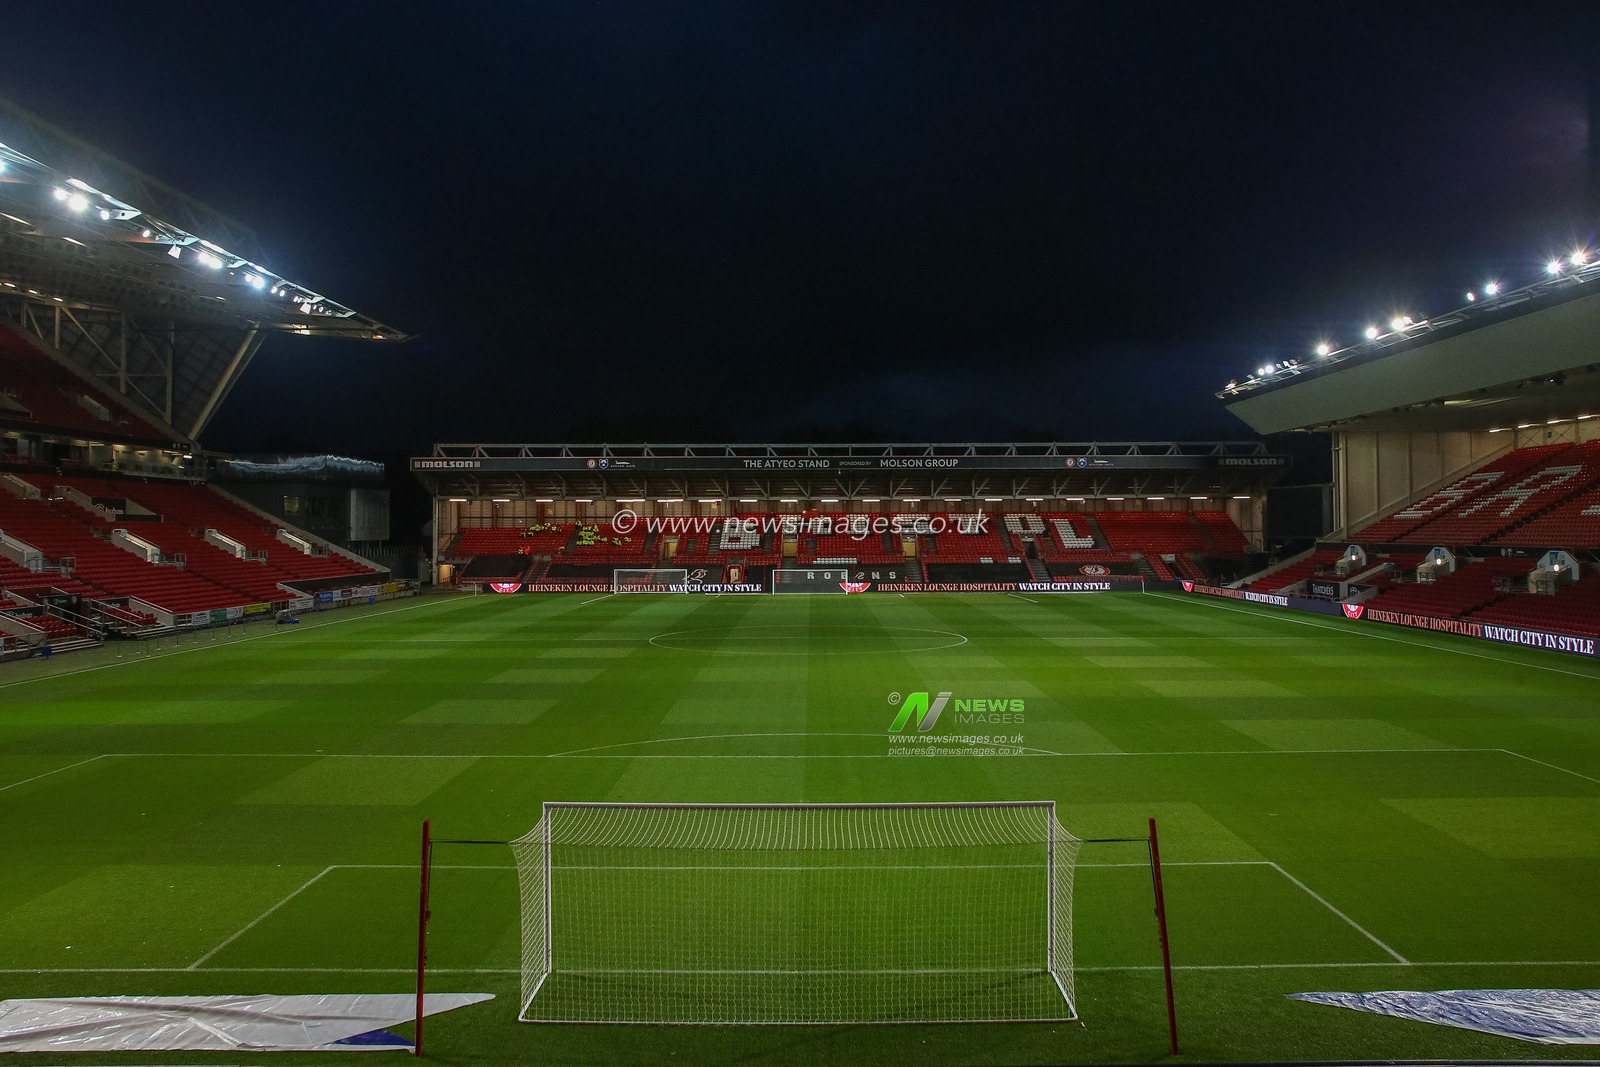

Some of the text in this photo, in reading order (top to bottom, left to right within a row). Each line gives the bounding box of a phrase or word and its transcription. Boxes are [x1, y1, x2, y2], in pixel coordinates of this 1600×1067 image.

[744, 460, 830, 468] THE ATYEO STAND
[880, 459, 959, 467] MOLSON GROUP
[1367, 608, 1594, 654] HEINEKEN LOUNGE HOSPITALITY WATCH CITY IN STYLE
